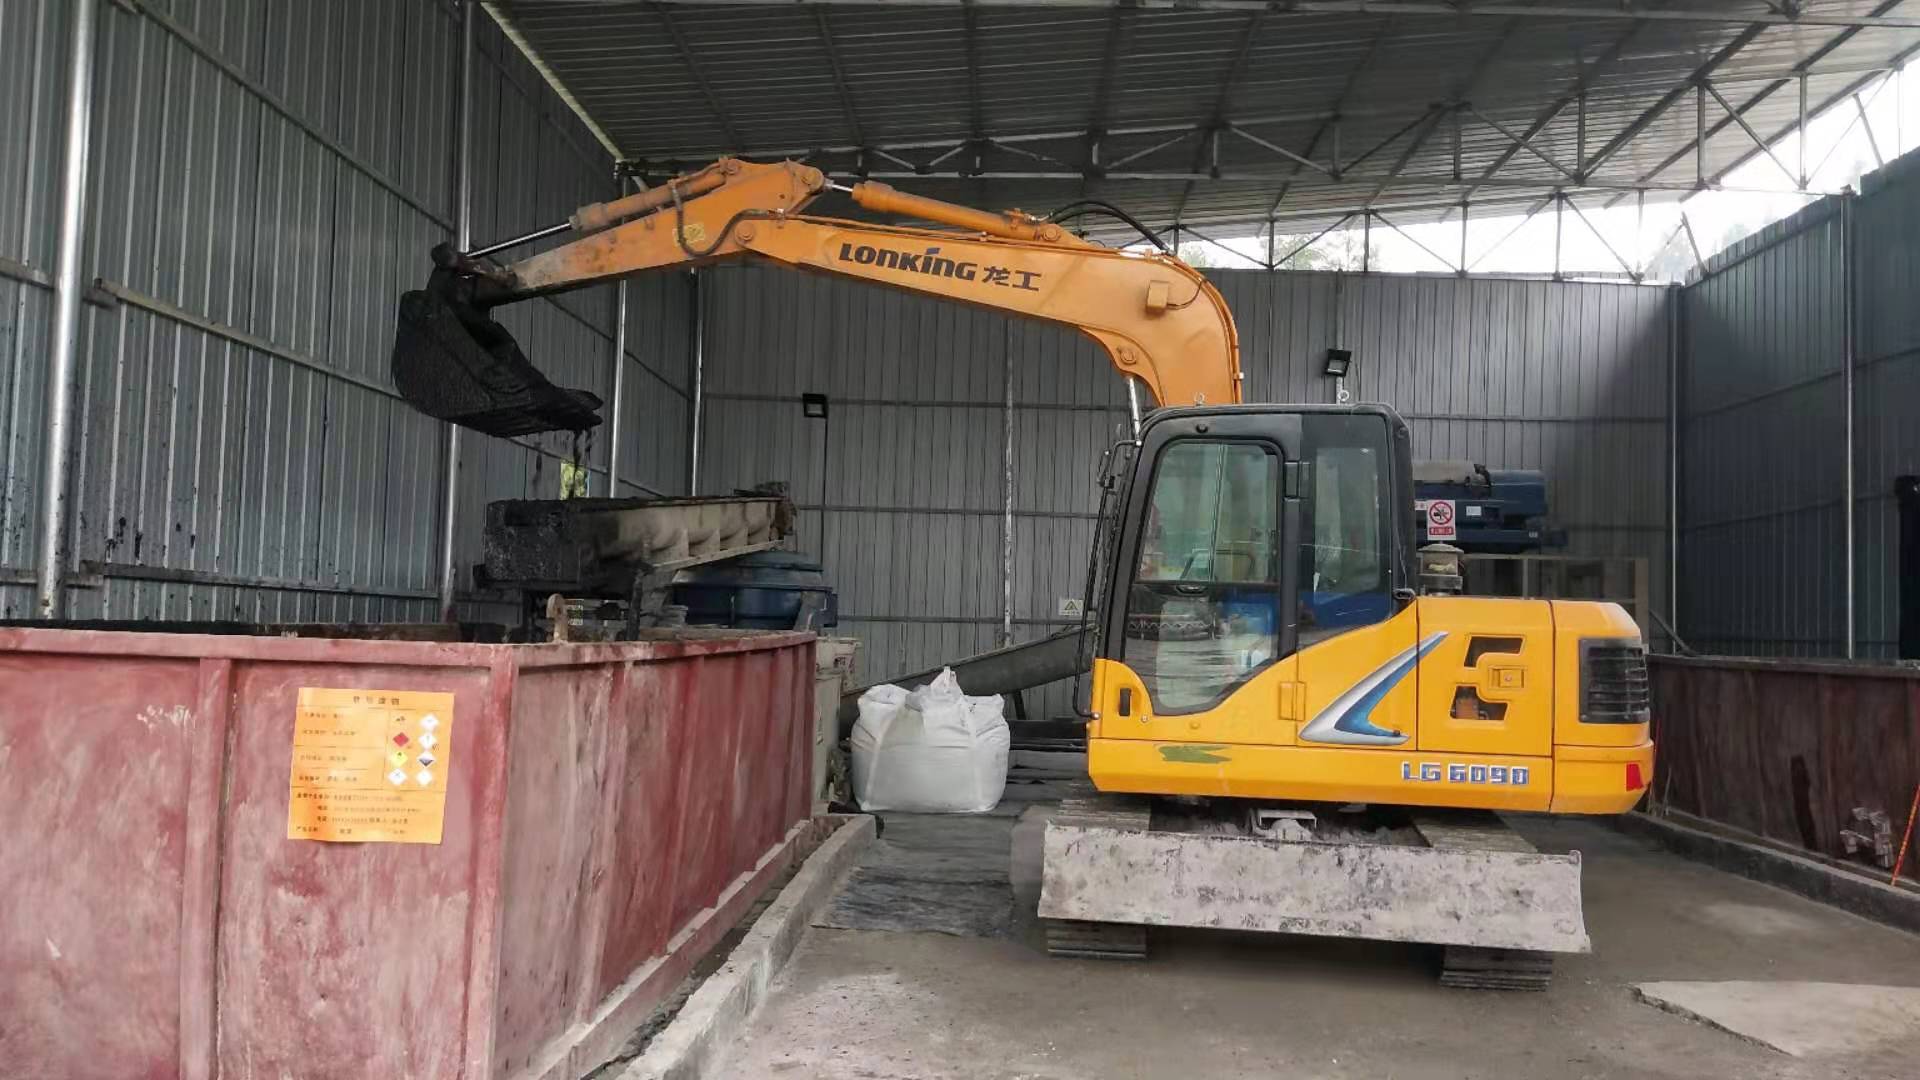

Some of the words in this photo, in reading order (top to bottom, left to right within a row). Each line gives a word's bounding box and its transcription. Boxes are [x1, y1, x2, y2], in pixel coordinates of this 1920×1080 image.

[982, 266, 1042, 291] 龙工
[1402, 761, 1441, 782] LG
[1448, 763, 1529, 785] 6090
